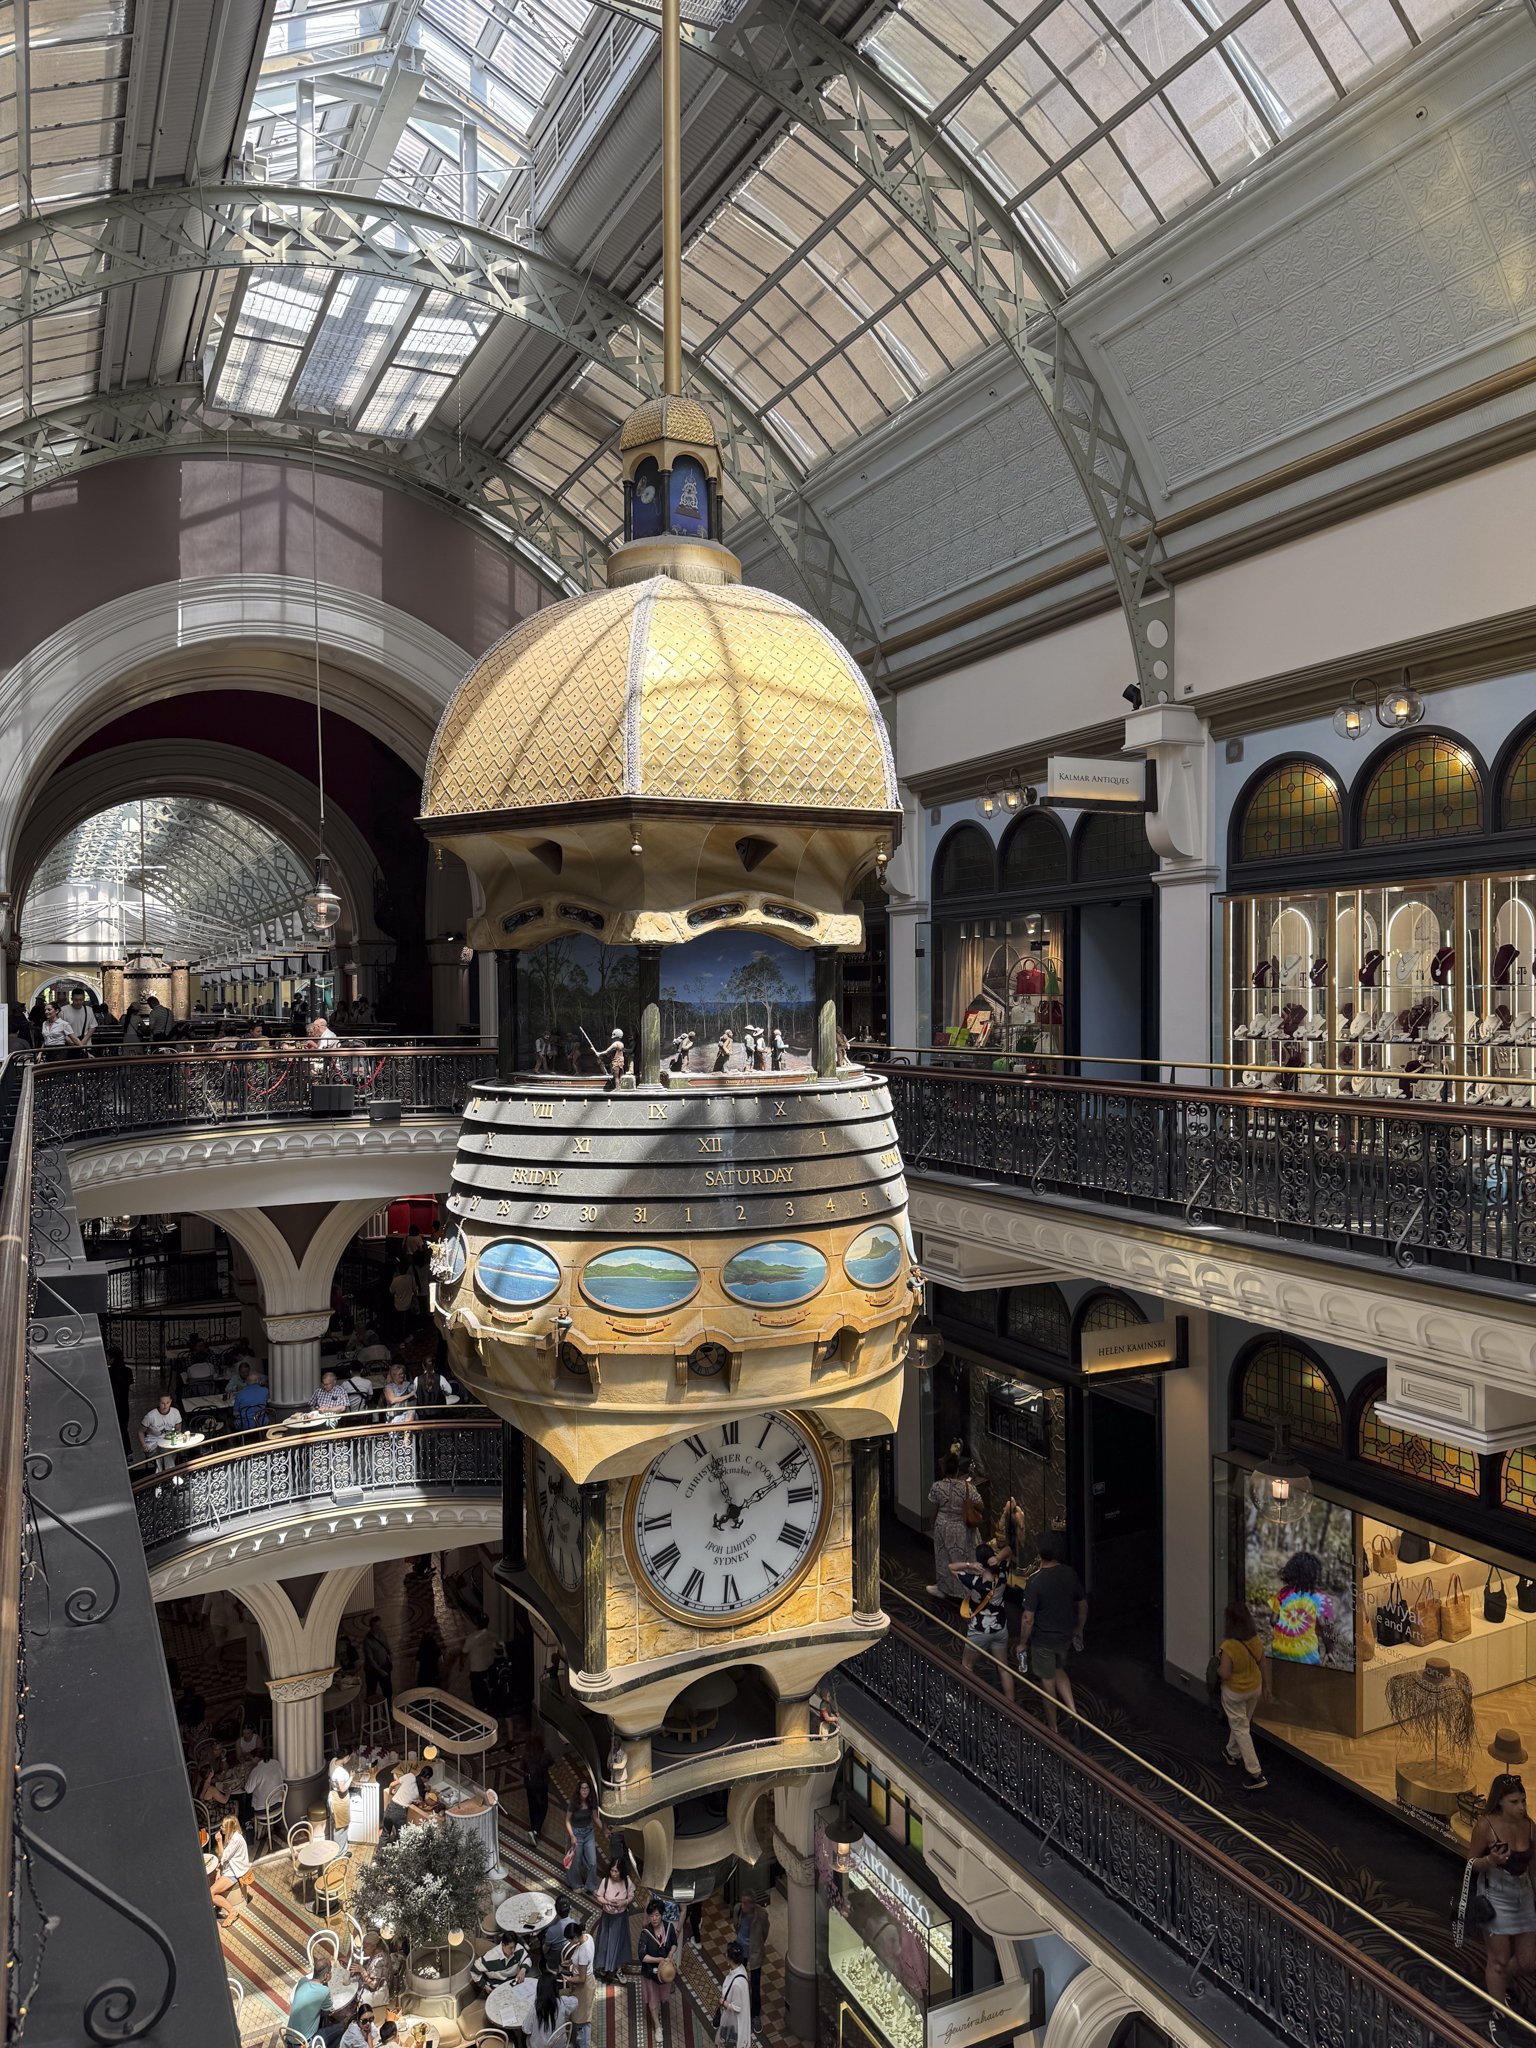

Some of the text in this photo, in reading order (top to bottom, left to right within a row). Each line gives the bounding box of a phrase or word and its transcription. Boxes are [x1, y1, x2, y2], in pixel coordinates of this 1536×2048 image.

[1058, 772, 1130, 785] KALMAR ANTIQUES
[531, 1103, 555, 1118] VIII
[648, 1104, 668, 1120] IX
[774, 1101, 787, 1117] X
[485, 1132, 496, 1149] X
[572, 1137, 592, 1154] XI
[698, 1137, 723, 1153] XII
[819, 1131, 827, 1146] I
[511, 1168, 564, 1187] FRIDAY
[704, 1166, 794, 1188] SATURDAY
[496, 1200, 511, 1216] 28
[533, 1204, 551, 1220] 29
[580, 1206, 598, 1223] 30
[633, 1207, 648, 1224] 31
[684, 1207, 692, 1224] 1
[735, 1205, 747, 1221] 2
[786, 1201, 795, 1218] 3
[825, 1197, 836, 1213] 4
[861, 1192, 869, 1207] 5
[886, 1186, 893, 1202] 6
[1098, 1339, 1166, 1357] HELEN KAMINSKI
[757, 1420, 774, 1450] I
[653, 1467, 684, 1492] X
[684, 1453, 775, 1499] CHRISTPHER C COOK
[707, 1465, 752, 1484] Ckmaker
[787, 1484, 814, 1507] III
[644, 1508, 673, 1536] IX
[776, 1519, 809, 1550] IIII
[704, 1533, 757, 1555] IPOH LIMITED
[650, 1539, 682, 1583] VIII
[712, 1551, 750, 1566] SYDNEY
[678, 1566, 706, 1603] VII
[761, 1559, 782, 1586] V
[721, 1574, 743, 1605] VI
[1384, 1618, 1425, 1643] and Arts
[860, 1848, 931, 1928] ART DECO
